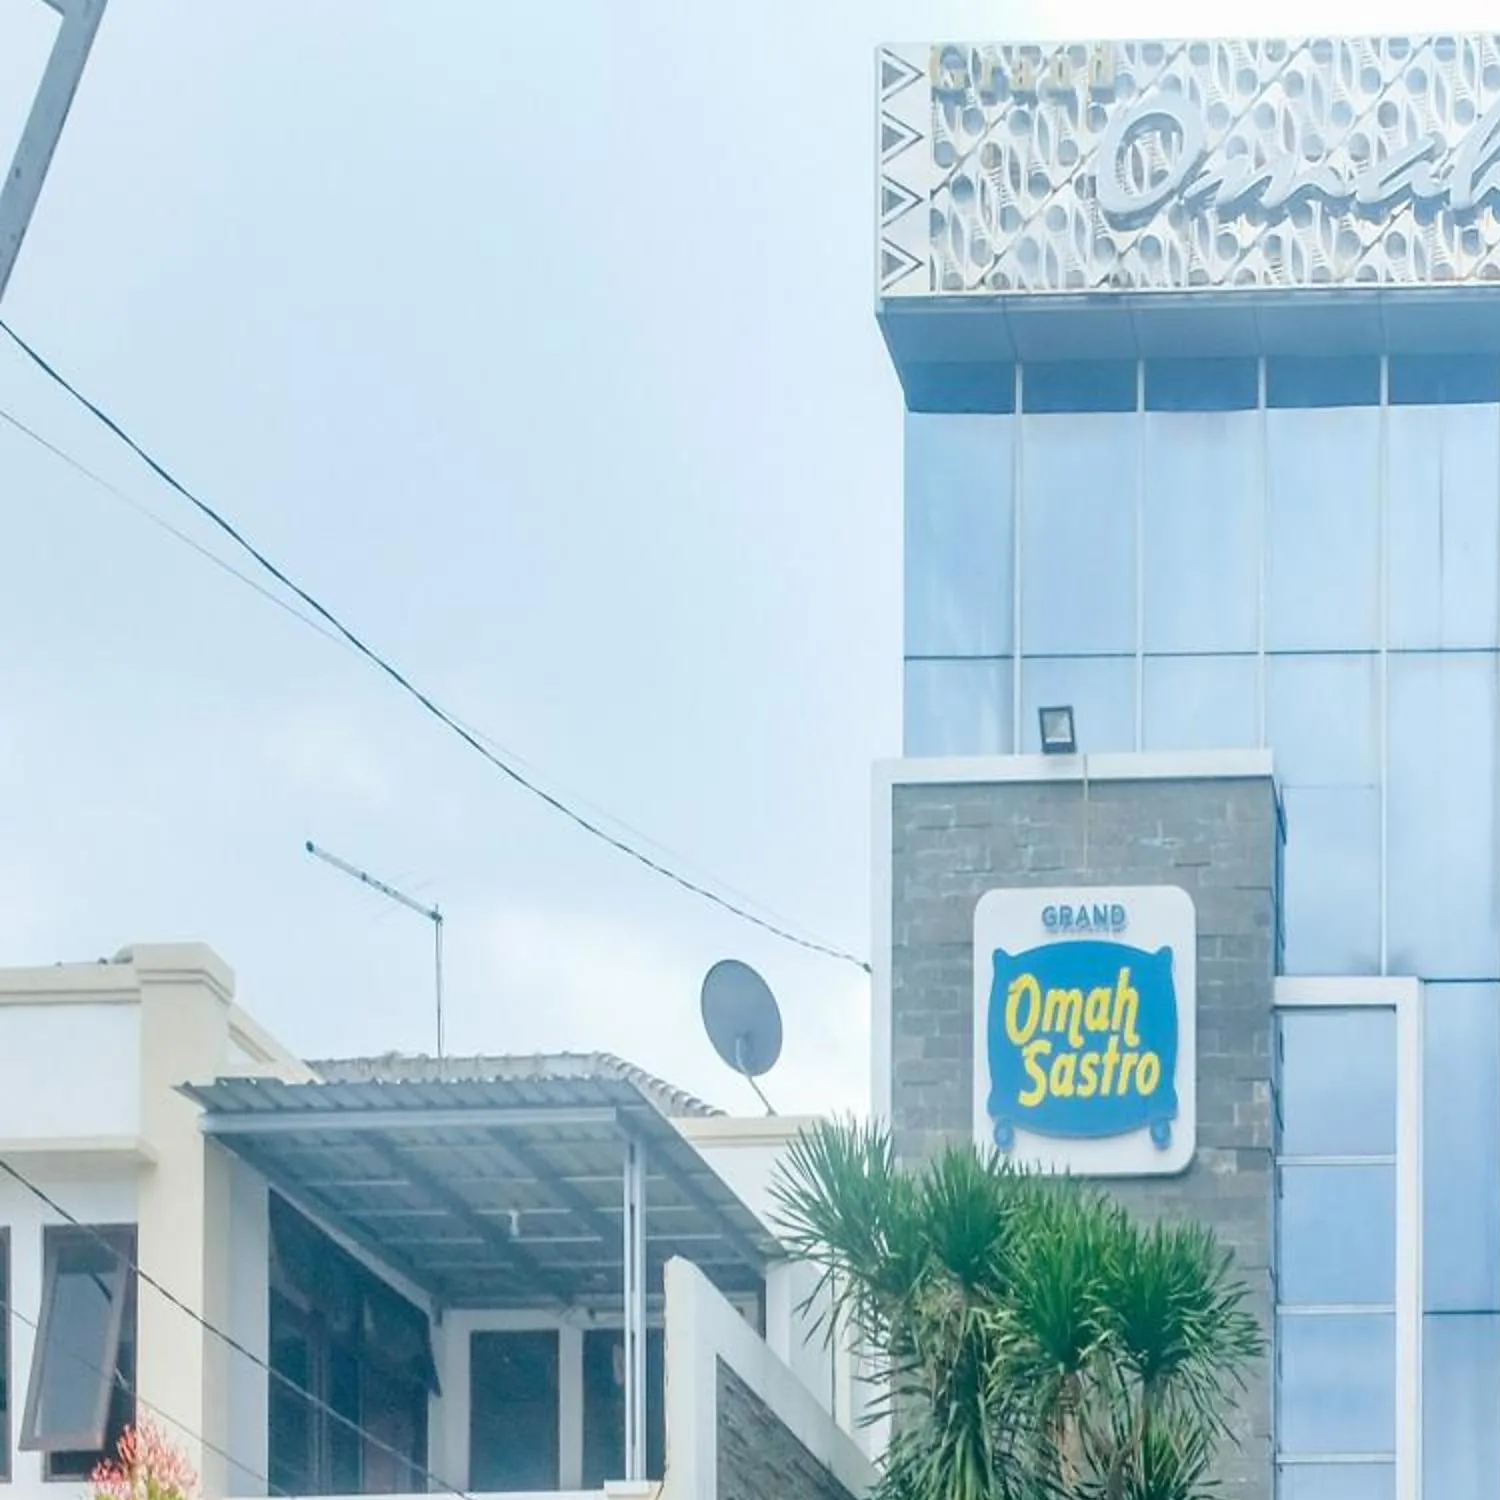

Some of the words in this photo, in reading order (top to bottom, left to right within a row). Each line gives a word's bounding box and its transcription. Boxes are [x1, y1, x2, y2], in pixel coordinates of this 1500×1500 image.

[1042, 904, 1126, 929] GRAND
[1005, 967, 1140, 1047] Omah
[1018, 1036, 1160, 1107] Sastro
